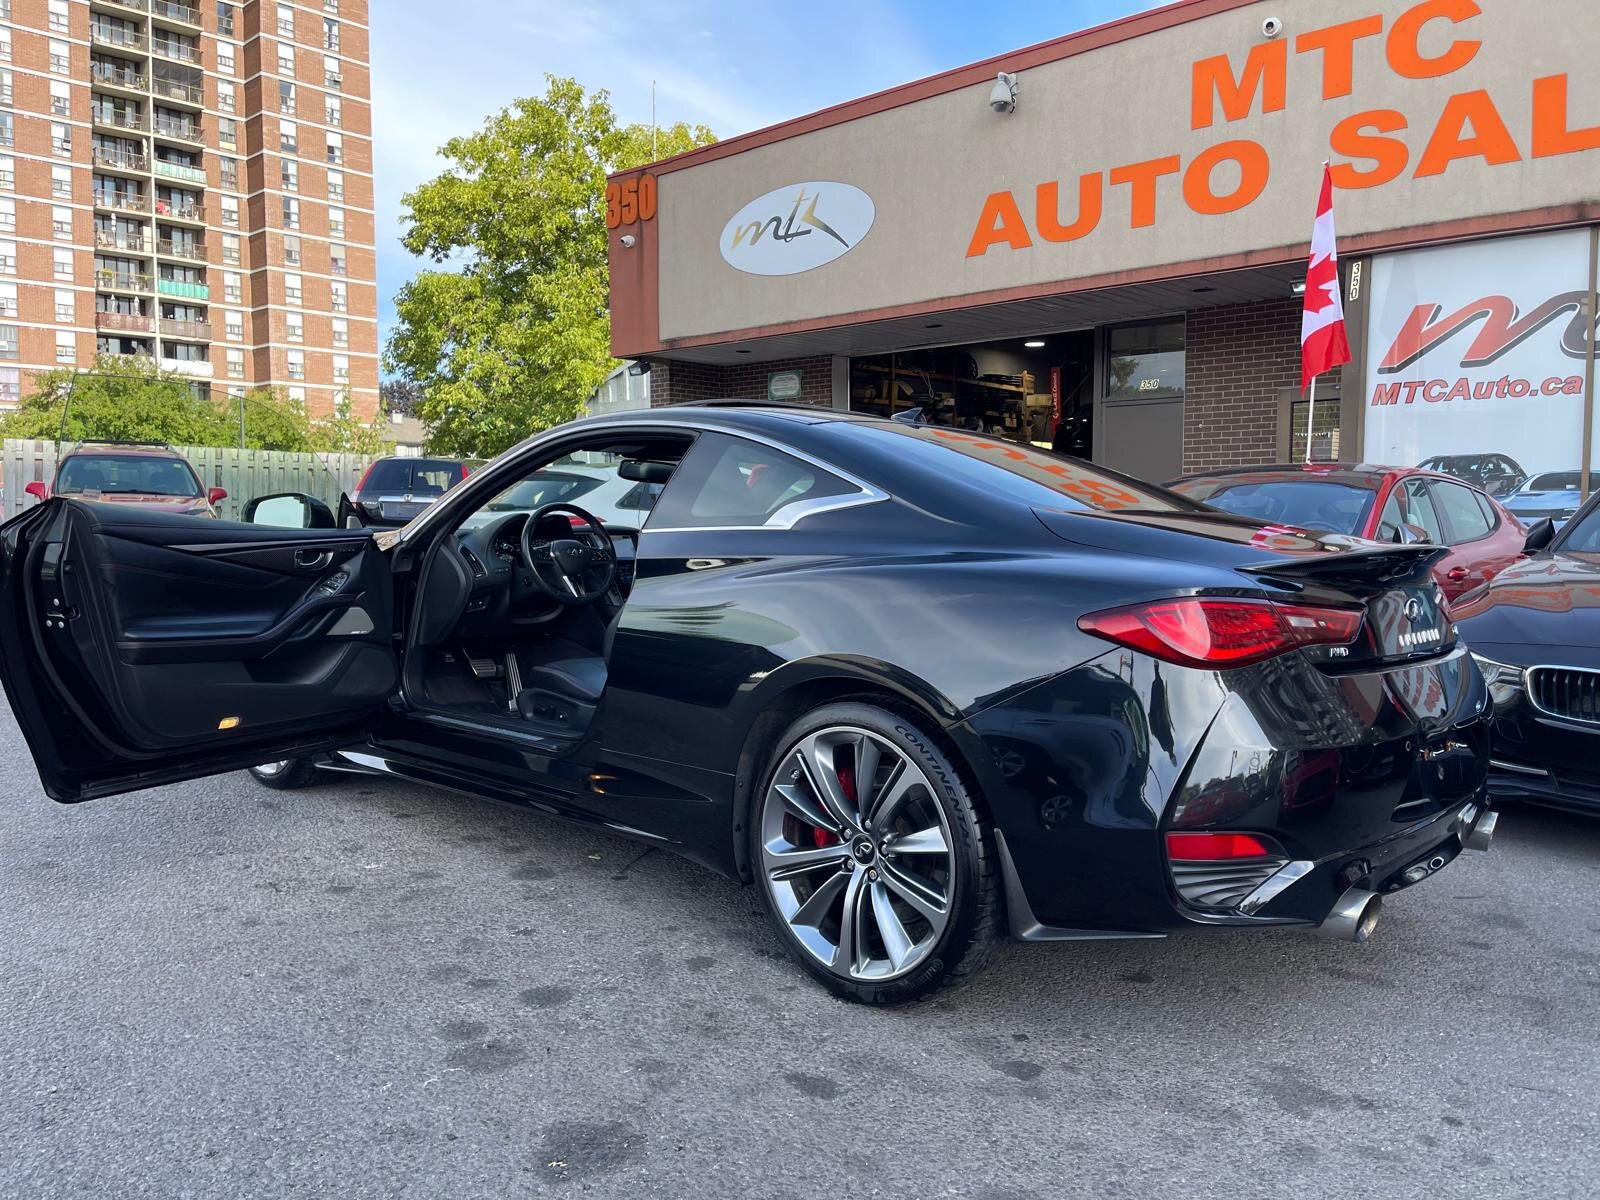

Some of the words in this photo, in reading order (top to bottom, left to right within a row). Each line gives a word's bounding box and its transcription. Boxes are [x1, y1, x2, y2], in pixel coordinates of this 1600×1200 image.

[1191, 0, 1482, 130] MTC
[965, 139, 1270, 258] AUTO
[1328, 73, 1600, 190] SAL
[606, 174, 657, 229] 350
[1350, 263, 1361, 299] 350
[1140, 378, 1160, 391] 350
[1371, 375, 1584, 406] MTCAuto.ca
